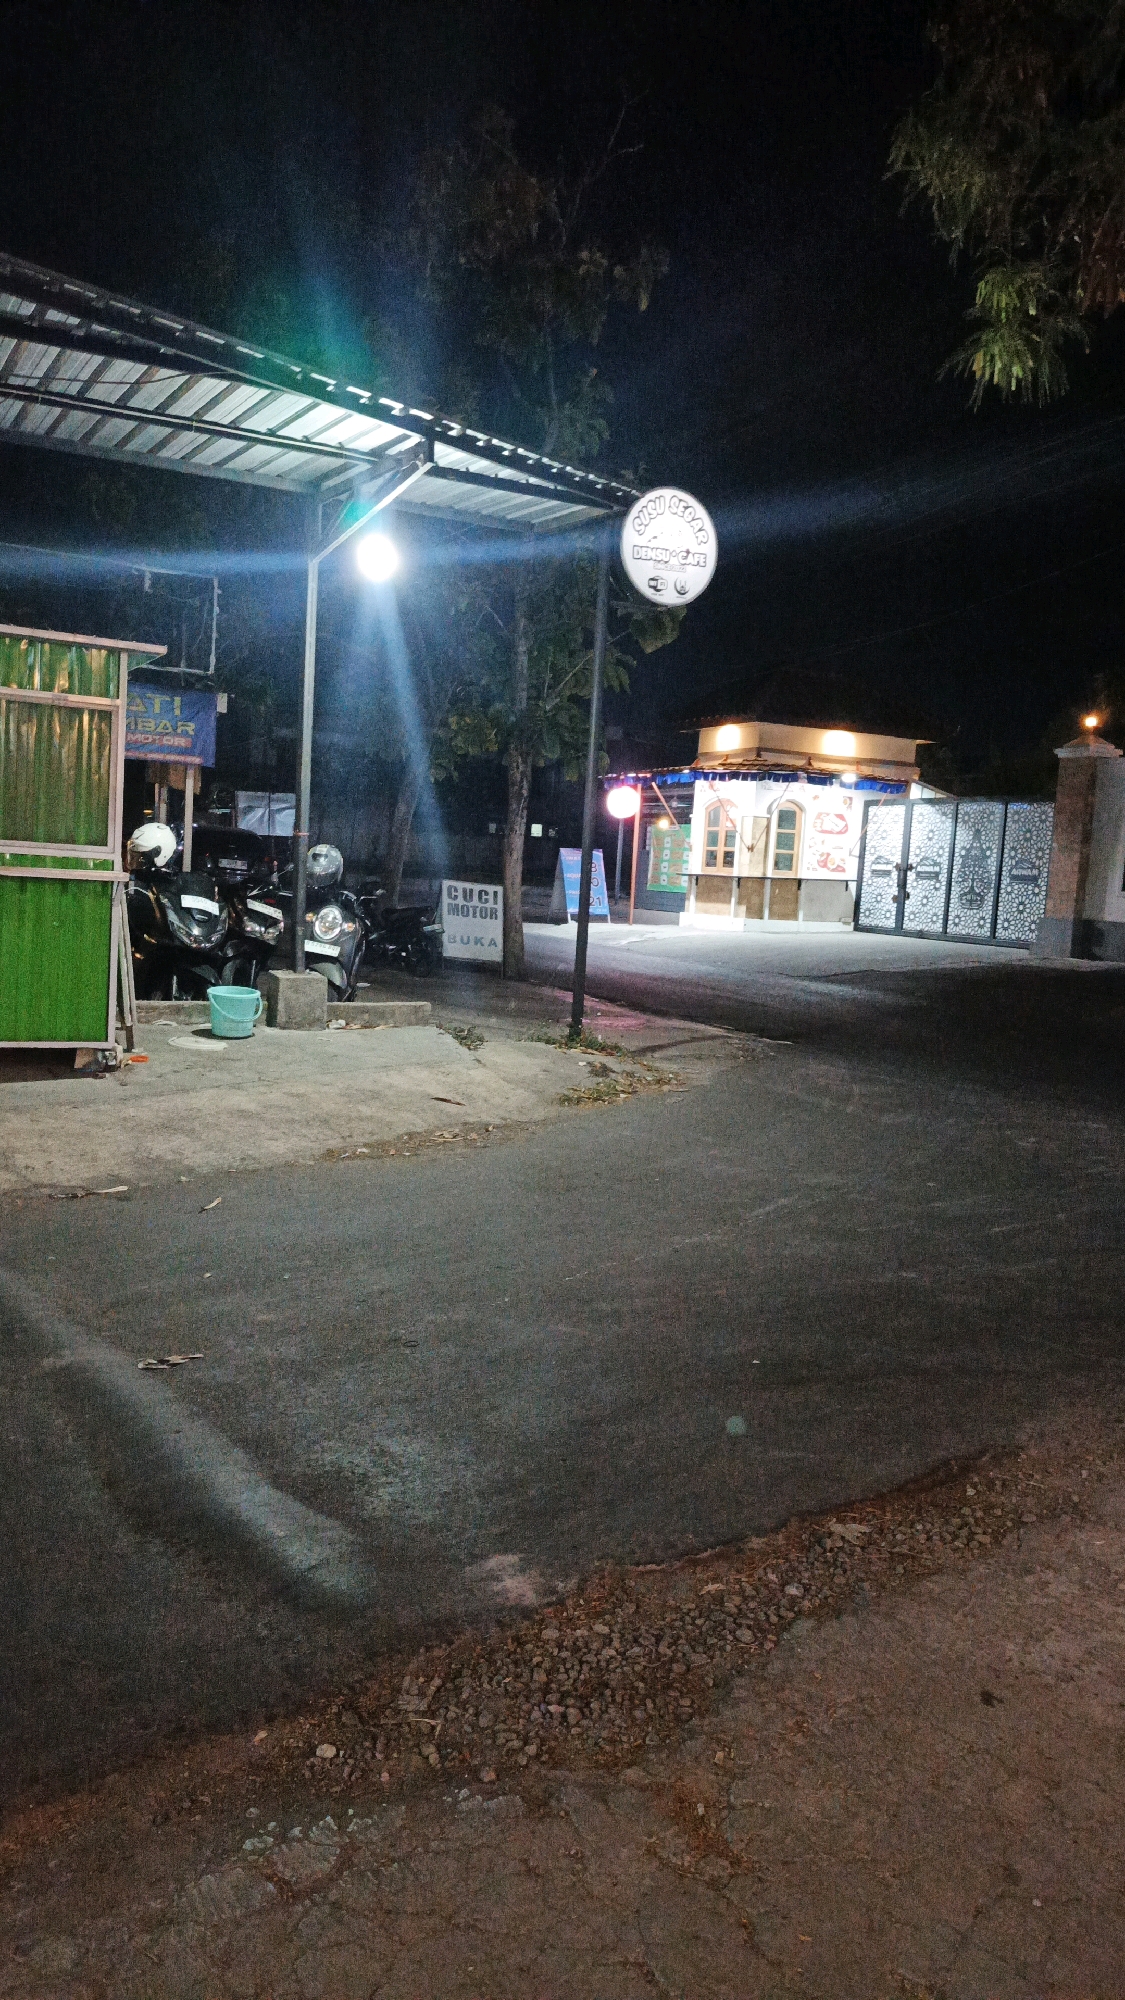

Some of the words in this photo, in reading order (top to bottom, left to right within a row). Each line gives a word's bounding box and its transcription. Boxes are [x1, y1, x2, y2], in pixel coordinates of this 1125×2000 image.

[633, 495, 665, 535] SUSU
[668, 495, 709, 545] SEGAR
[633, 545, 670, 562] DENSU
[677, 550, 707, 567] CAFE
[127, 733, 186, 747] MOTOR
[447, 885, 498, 905] CUCI
[447, 903, 498, 920] MOTOR
[447, 934, 498, 948] BUKA
